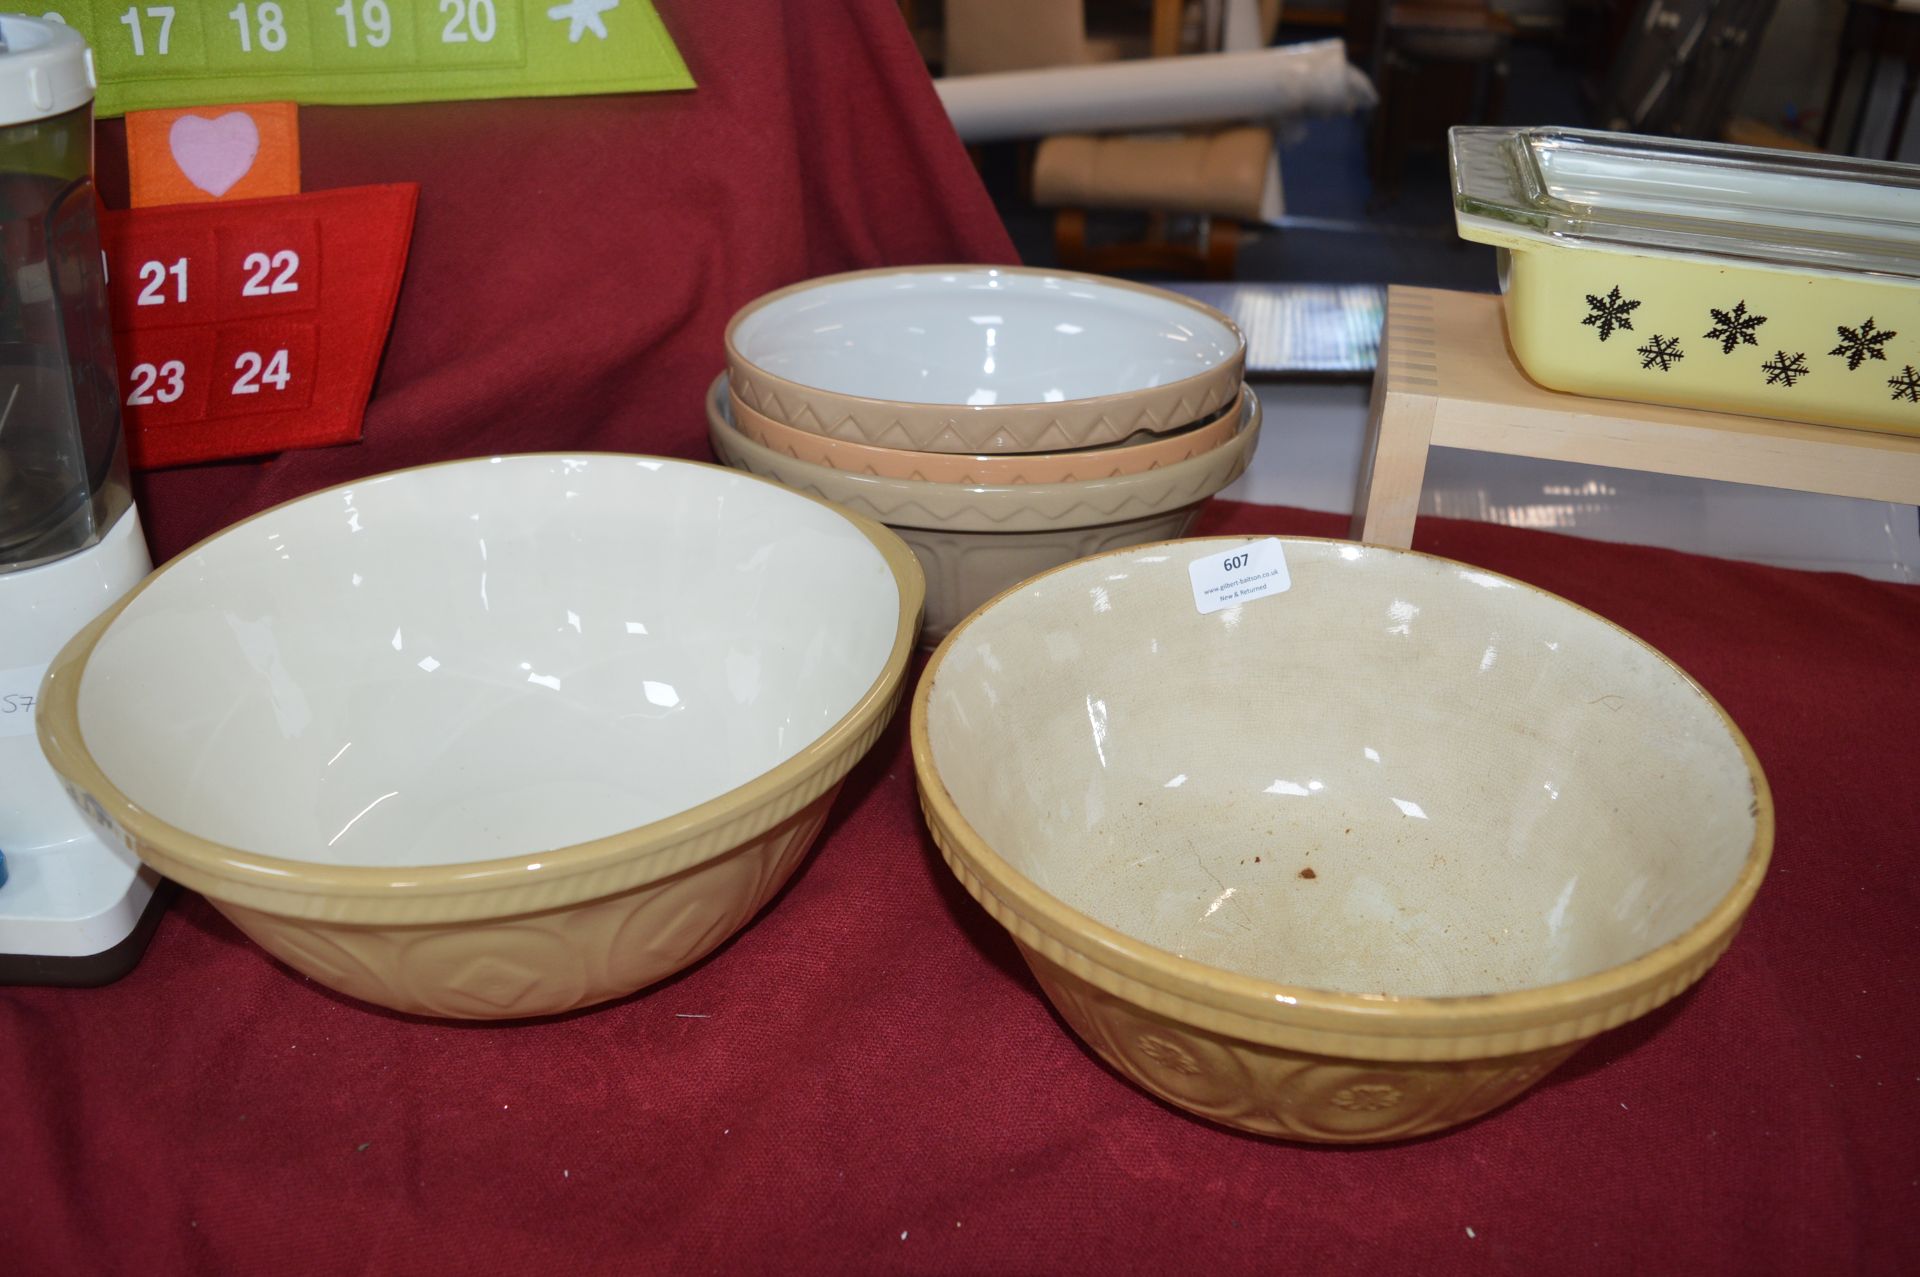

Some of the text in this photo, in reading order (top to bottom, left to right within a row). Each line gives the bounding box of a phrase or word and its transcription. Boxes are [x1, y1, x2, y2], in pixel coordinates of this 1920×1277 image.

[121, 0, 496, 56] 17 18 19 20
[137, 250, 299, 306] 21 22
[126, 349, 291, 406] 23 24
[1223, 553, 1249, 571] 607
[1240, 584, 1267, 595] Returned
